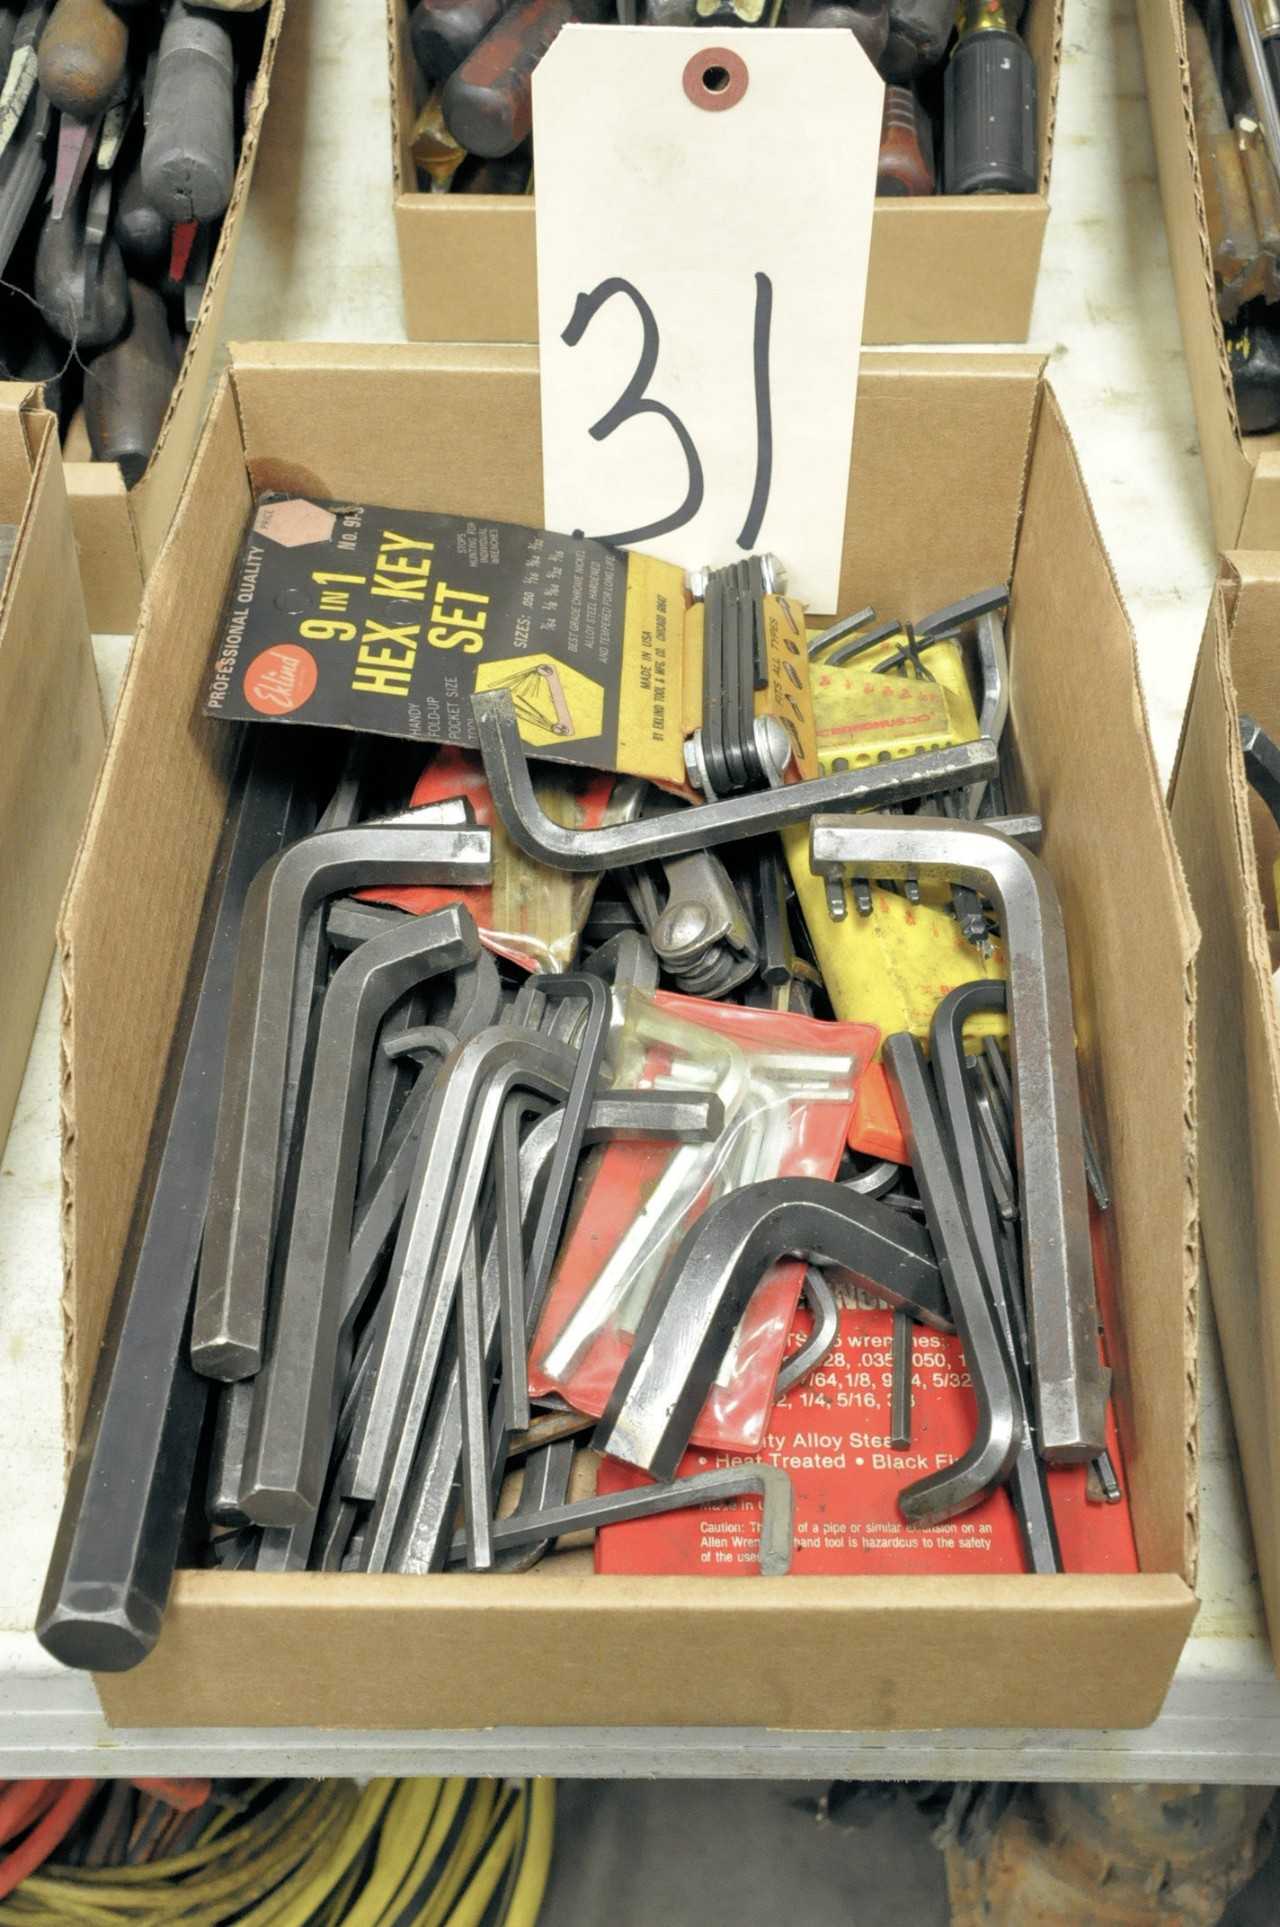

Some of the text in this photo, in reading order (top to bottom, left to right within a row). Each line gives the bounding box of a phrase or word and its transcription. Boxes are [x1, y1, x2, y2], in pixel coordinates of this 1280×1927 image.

[560, 272, 773, 551] 31
[299, 571, 366, 641] 9 IN 1
[351, 530, 435, 696] HEX KEY
[427, 581, 490, 654] SET
[208, 546, 265, 708] PROFESSIONAL QUALITY
[513, 614, 531, 648] SIZES:
[640, 631, 652, 689] MADE IN USA
[407, 702, 421, 736] HANDY
[426, 696, 440, 737] FOLD-UP
[444, 676, 461, 739] POCKET SIZE
[846, 1373, 876, 1390] 1/8,
[800, 1393, 831, 1409] 1/4,
[837, 1393, 881, 1410] 5/16,
[793, 1433, 842, 1450] Alloy
[769, 1453, 845, 1468] Treated
[872, 1454, 928, 1470] Black
[700, 1521, 744, 1533] Caution:
[798, 1521, 808, 1533] of
[812, 1524, 820, 1533] a
[823, 1522, 847, 1536] pipe
[850, 1524, 860, 1533] or
[865, 1522, 900, 1533] similar
[961, 1524, 974, 1533] on
[979, 1524, 992, 1533] an
[701, 1536, 727, 1548] Allen
[794, 1537, 820, 1548] hand
[825, 1536, 844, 1548] tool
[848, 1537, 857, 1548] is
[863, 1537, 918, 1549] hazardous
[922, 1537, 934, 1548] to
[937, 1536, 954, 1548] the
[958, 1537, 991, 1551] safety
[701, 1552, 711, 1563] of
[716, 1552, 732, 1563] the
